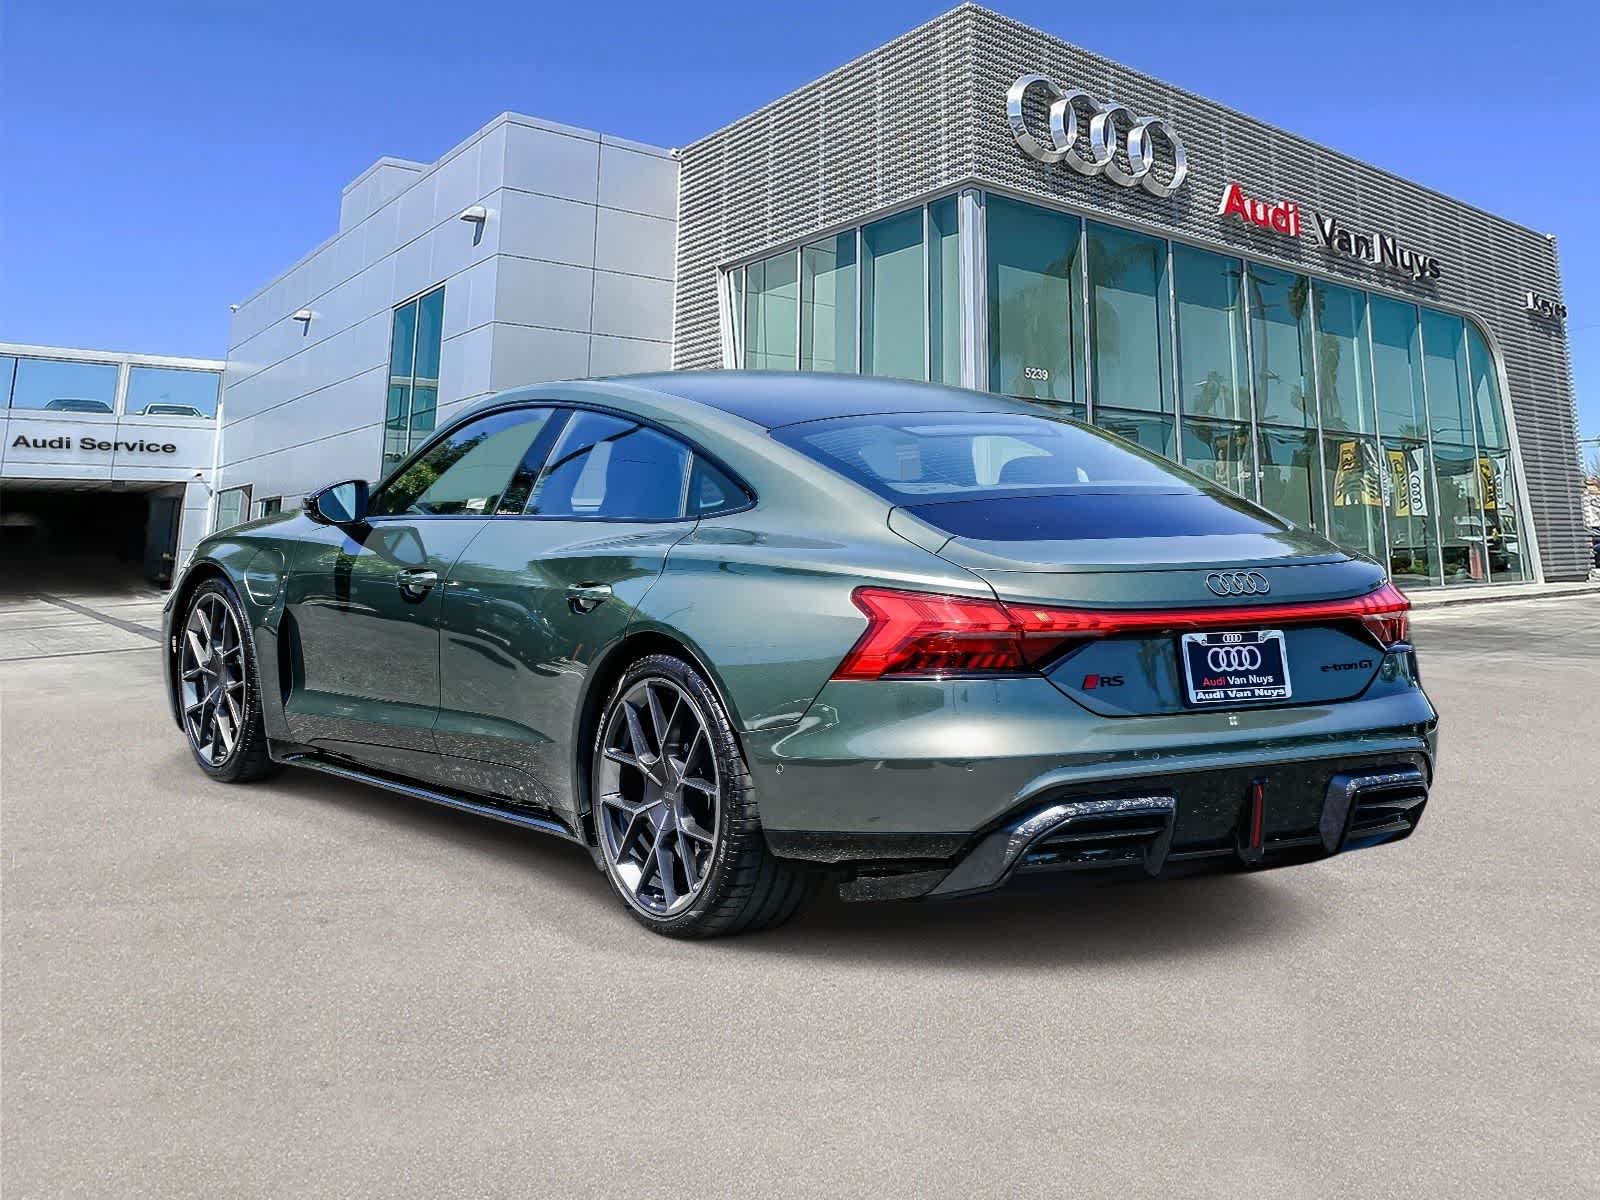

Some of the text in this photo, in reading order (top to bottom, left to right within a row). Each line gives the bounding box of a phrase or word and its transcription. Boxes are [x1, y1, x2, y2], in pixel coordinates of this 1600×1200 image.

[1218, 184, 1441, 280] Audi Van Nuys
[1024, 367, 1049, 381] 5239
[12, 434, 177, 454] Audi Service
[1320, 662, 1358, 672] e-tron
[1100, 675, 1125, 688] RS
[1202, 674, 1274, 687] Audi Van Nuys
[1196, 688, 1286, 700] Audi Van Nuys
